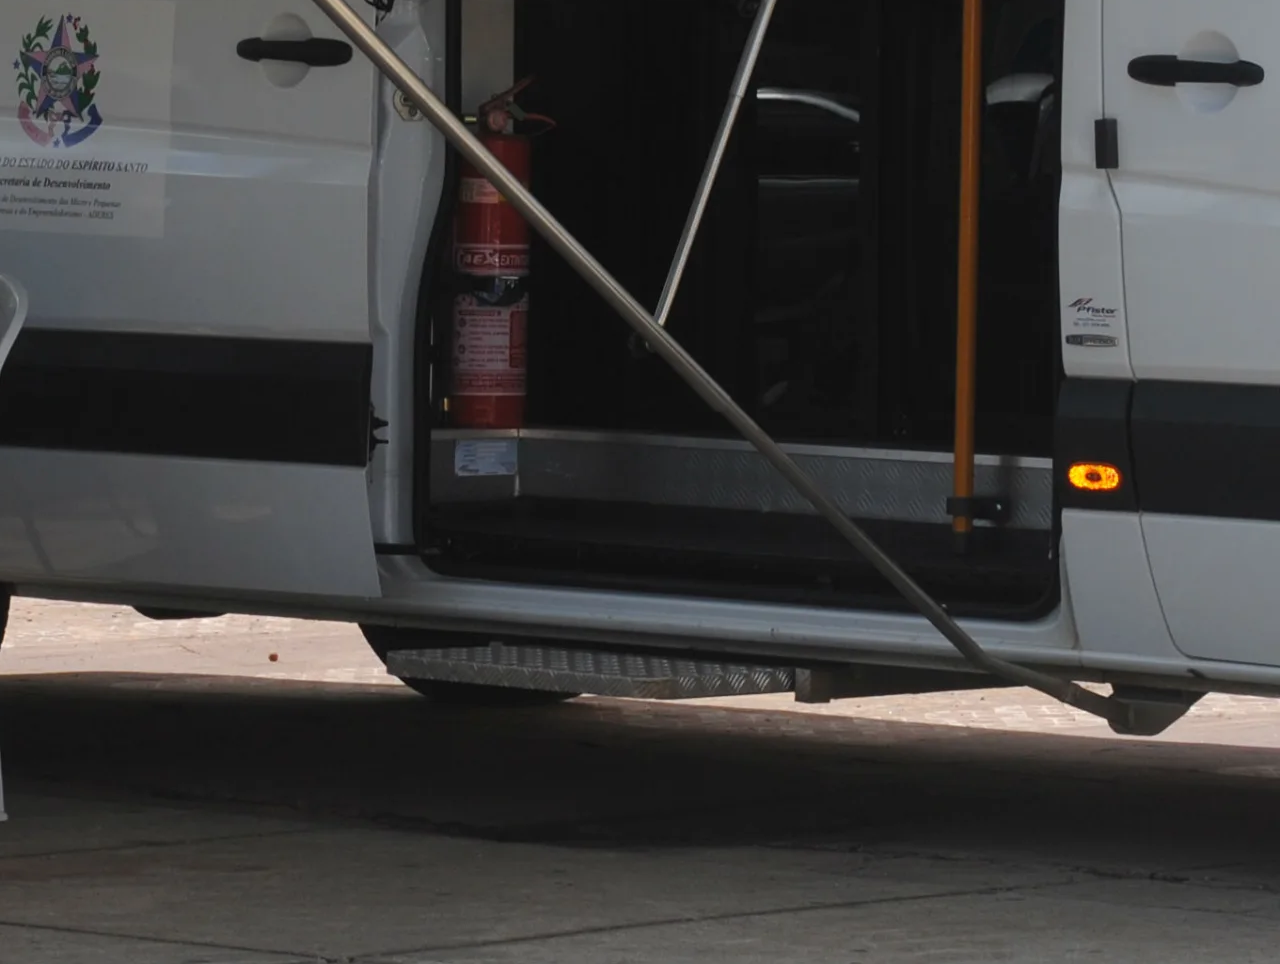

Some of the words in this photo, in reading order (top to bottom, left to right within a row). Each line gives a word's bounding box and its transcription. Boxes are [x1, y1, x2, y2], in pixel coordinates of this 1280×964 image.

[2, 157, 17, 168] DO
[18, 157, 54, 170] ESTADO
[56, 159, 70, 170] DO
[71, 157, 115, 172] ESPÍRITO
[116, 161, 149, 174] SANTO
[32, 176, 42, 187] de
[43, 176, 111, 191] Desenvolvimento
